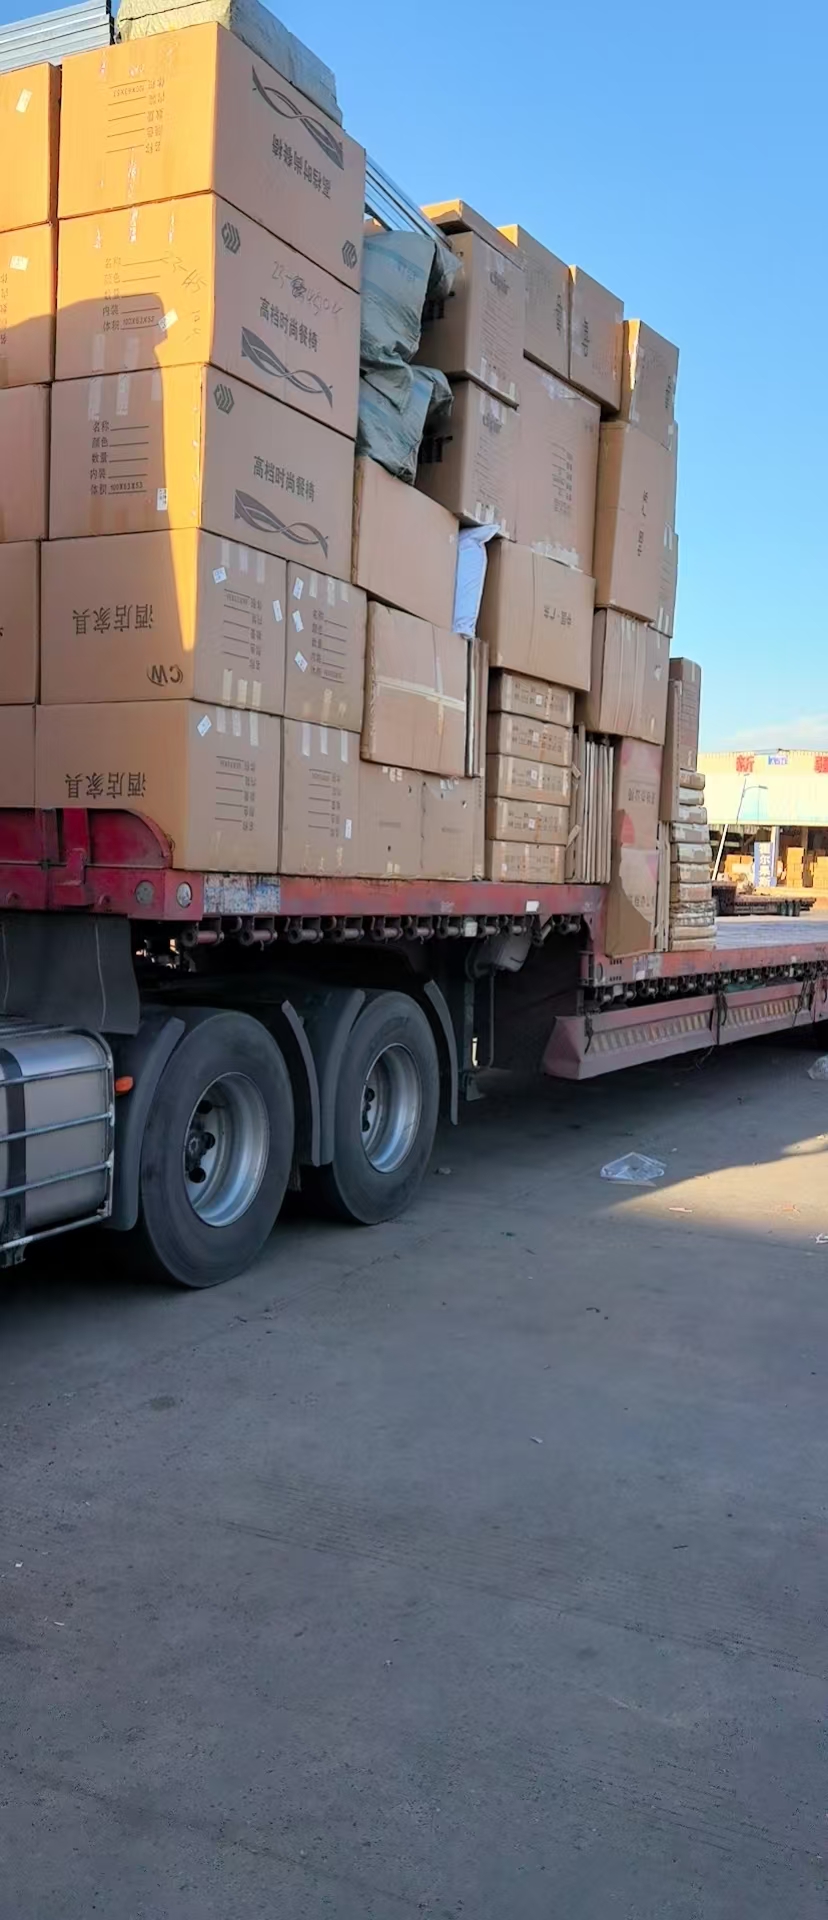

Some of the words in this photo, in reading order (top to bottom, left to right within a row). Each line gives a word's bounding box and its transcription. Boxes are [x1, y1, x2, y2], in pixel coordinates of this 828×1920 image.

[271, 133, 332, 200] 高档时尚餐椅
[102, 303, 119, 317] 内装
[102, 319, 120, 332] 体积
[259, 295, 320, 353] 高档时尚餐椅
[92, 420, 110, 433] 名称
[91, 436, 109, 449] 颜色
[91, 451, 109, 464] 数量
[89, 467, 107, 480] 内装
[253, 455, 316, 503] 高档时尚餐椅
[90, 483, 108, 496] 体积
[72, 603, 154, 636] 酒店家具
[151, 663, 182, 685] CW
[64, 771, 146, 800] 酒店家具
